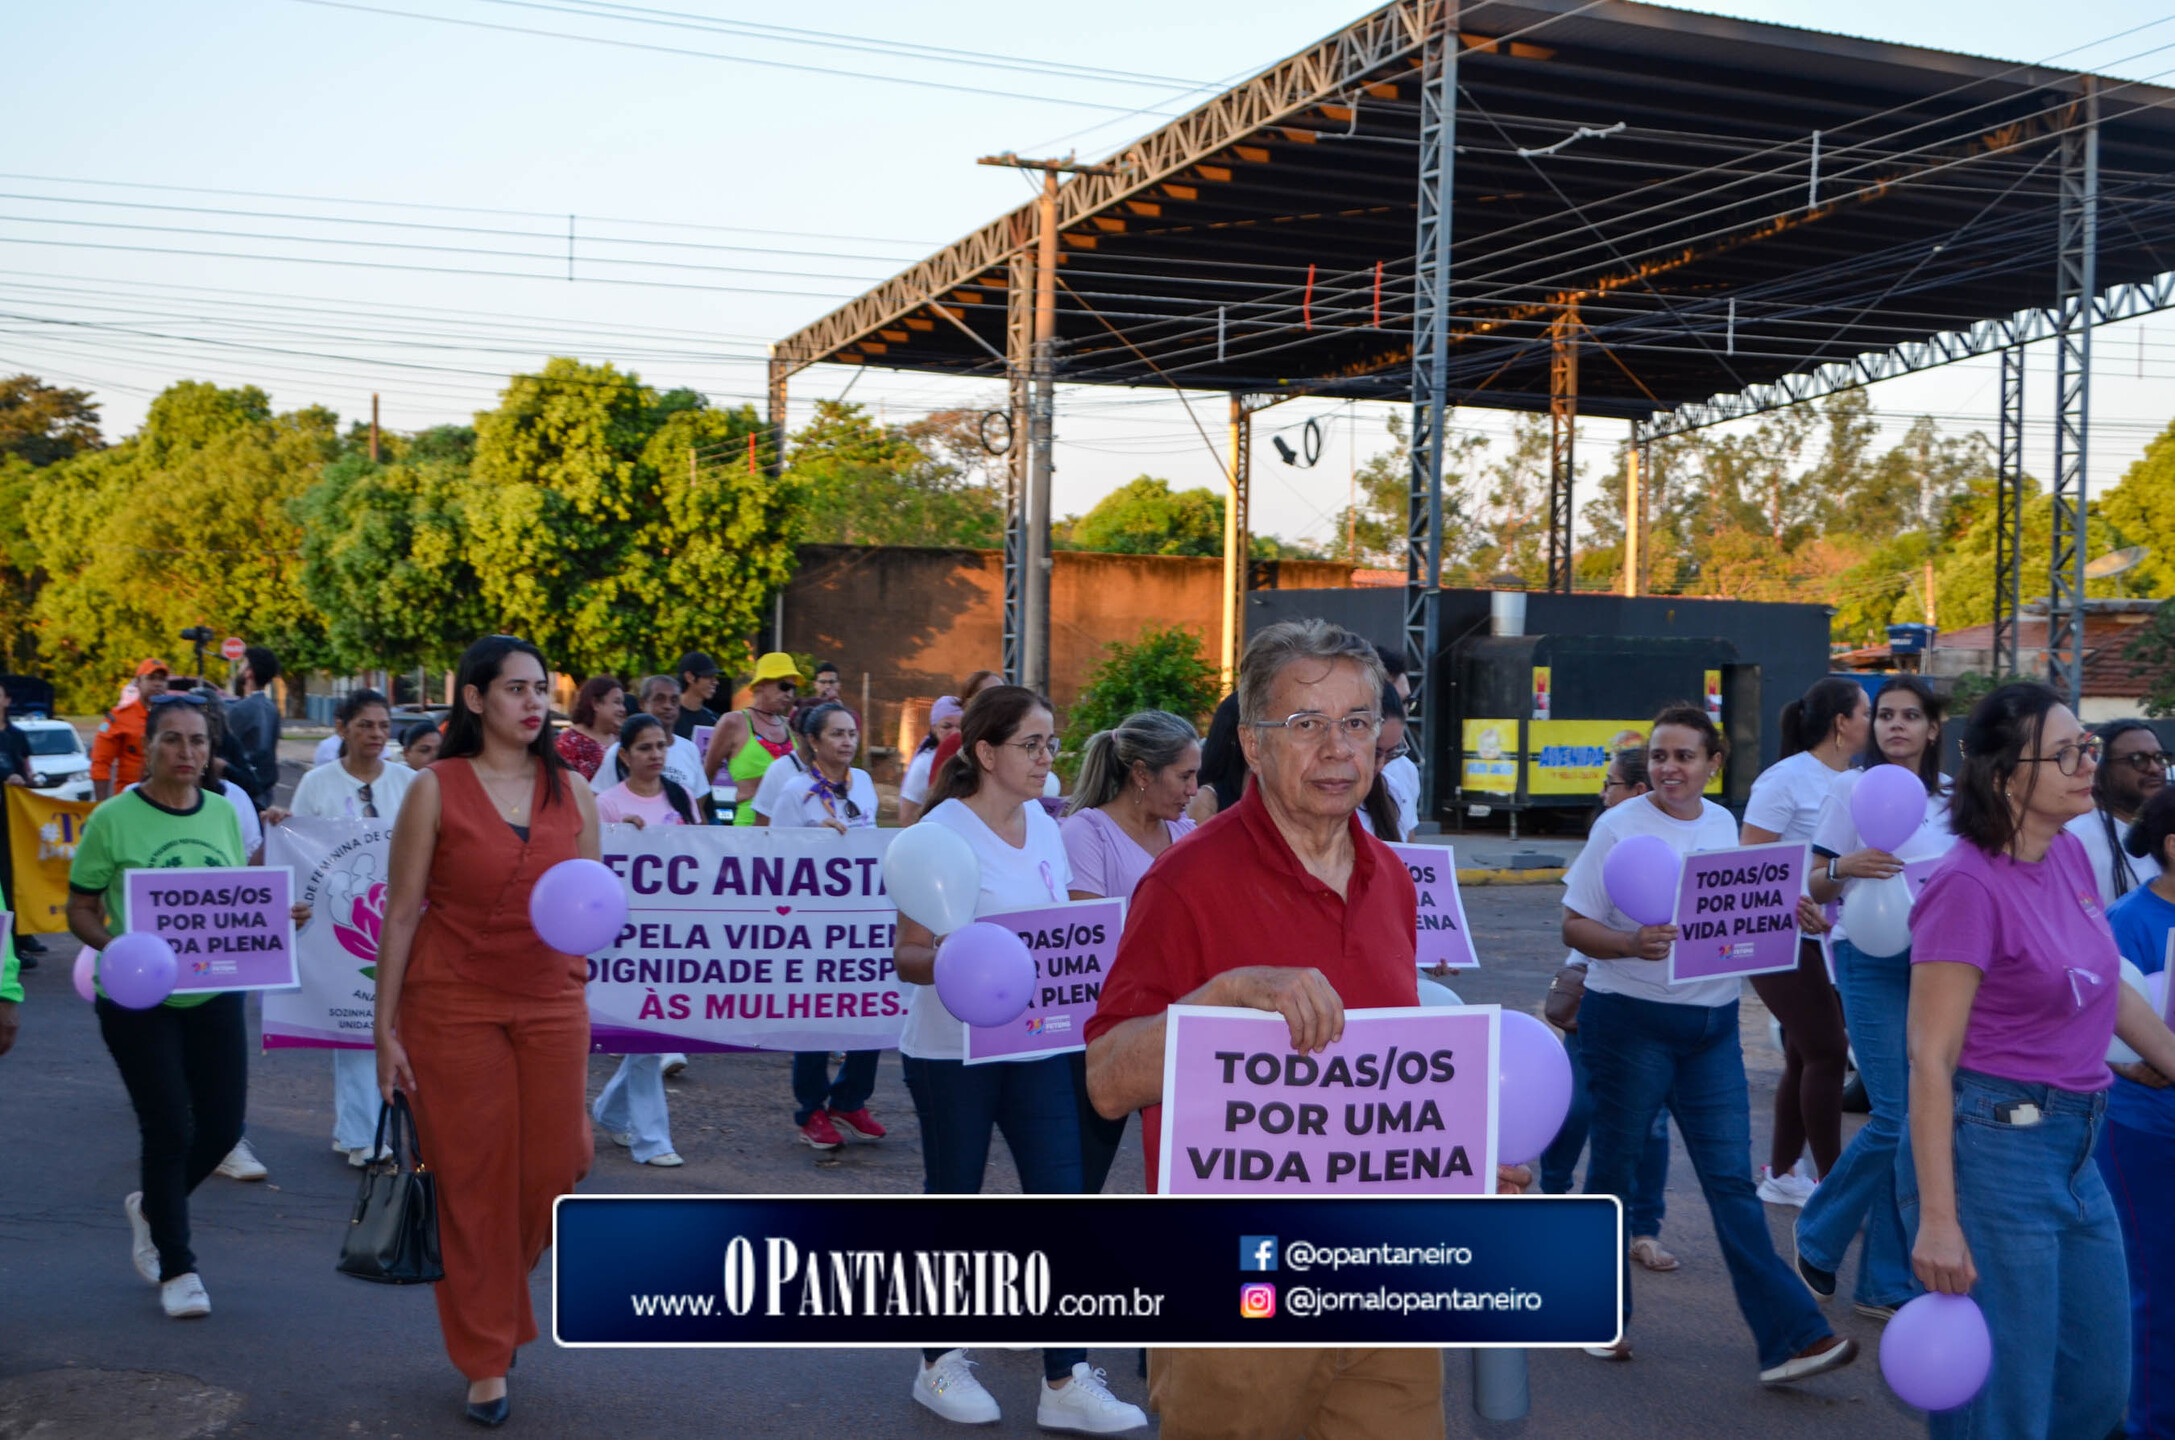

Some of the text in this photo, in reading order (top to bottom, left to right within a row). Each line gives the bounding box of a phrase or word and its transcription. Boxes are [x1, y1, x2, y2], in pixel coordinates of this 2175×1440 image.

[1539, 745, 1605, 768] AVENIDA
[713, 856, 886, 897] ANAST
[1697, 863, 1789, 889] TODAS/OS
[149, 886, 273, 908] TODAS/OS
[1696, 889, 1783, 914] POR UMA
[157, 912, 268, 931] POR UMA
[1682, 914, 1793, 941] VIDA PLENA
[208, 935, 284, 953] PLENA
[614, 923, 711, 949] PELA
[724, 924, 812, 949] VIDA
[587, 957, 773, 984] DIGNIDADE
[785, 959, 803, 983] E
[1048, 954, 1102, 978] UMA
[638, 987, 909, 1020] ÀS MULHERES.
[1042, 982, 1101, 1008] PLEN
[1214, 1046, 1456, 1091] TODAS/OS
[1225, 1099, 1445, 1136] POR UMA
[1187, 1145, 1474, 1183] VIDA PLENA
